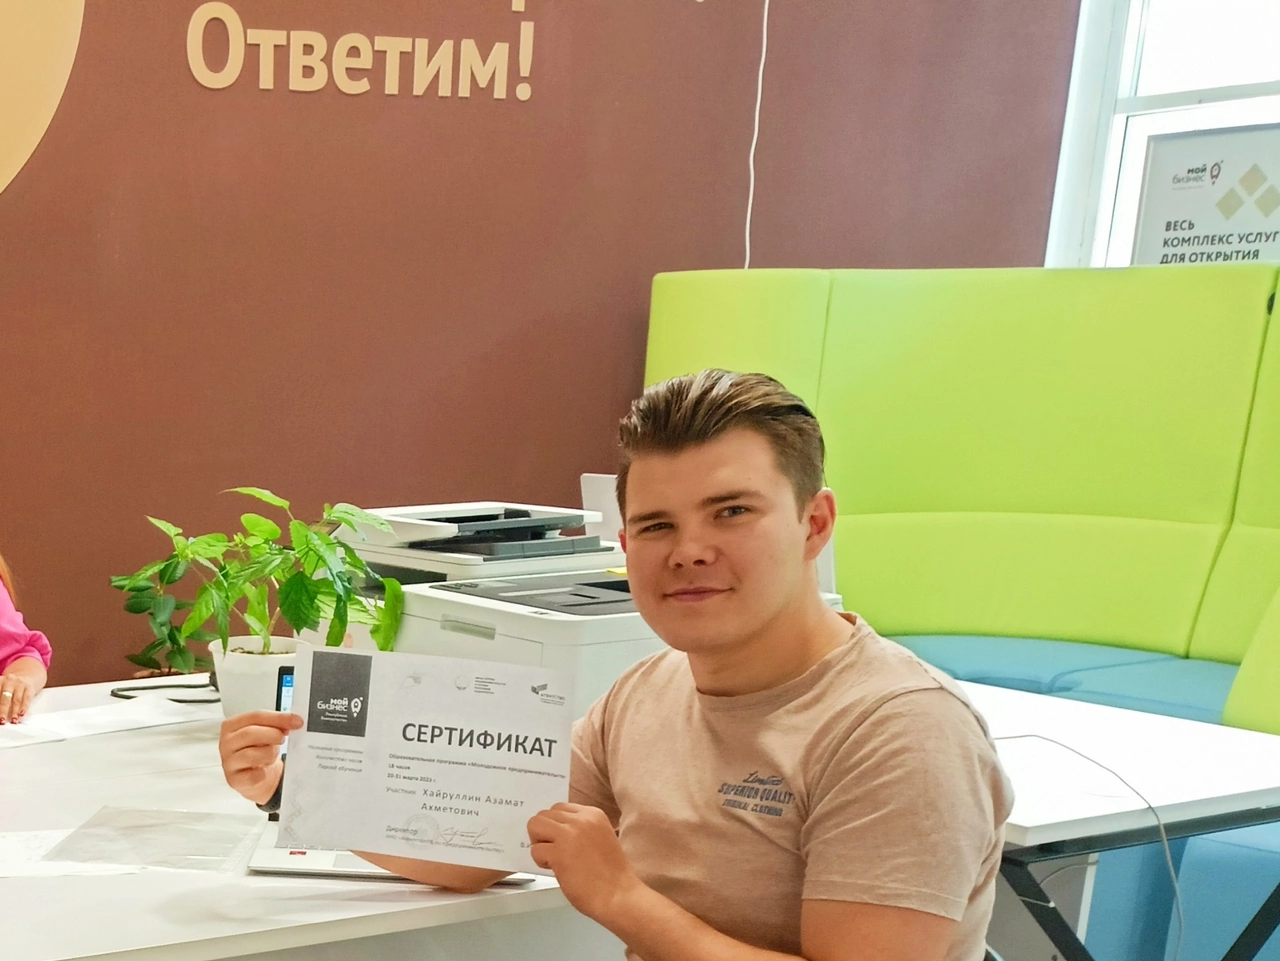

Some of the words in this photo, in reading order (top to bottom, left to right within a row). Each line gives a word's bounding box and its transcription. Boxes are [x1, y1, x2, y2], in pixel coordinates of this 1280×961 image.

[186, 1, 535, 101] Ответим!
[1187, 163, 1207, 175] мой
[1172, 173, 1205, 185] бизнес
[1165, 219, 1195, 232] ВЕСЬ
[1162, 233, 1234, 248] КОМПЛЕКС
[1237, 230, 1280, 245] УСЛУГ
[1160, 252, 1186, 265] ДЛЯ
[1188, 249, 1260, 264] ОТКРЫТИЯ
[317, 700, 348, 712] бизнес
[330, 697, 349, 706] мой
[402, 722, 558, 758] СЕРТИФИКАТ
[422, 788, 481, 803] Хайруллин
[484, 795, 525, 808] Азамат
[420, 802, 480, 817] Ахметович
